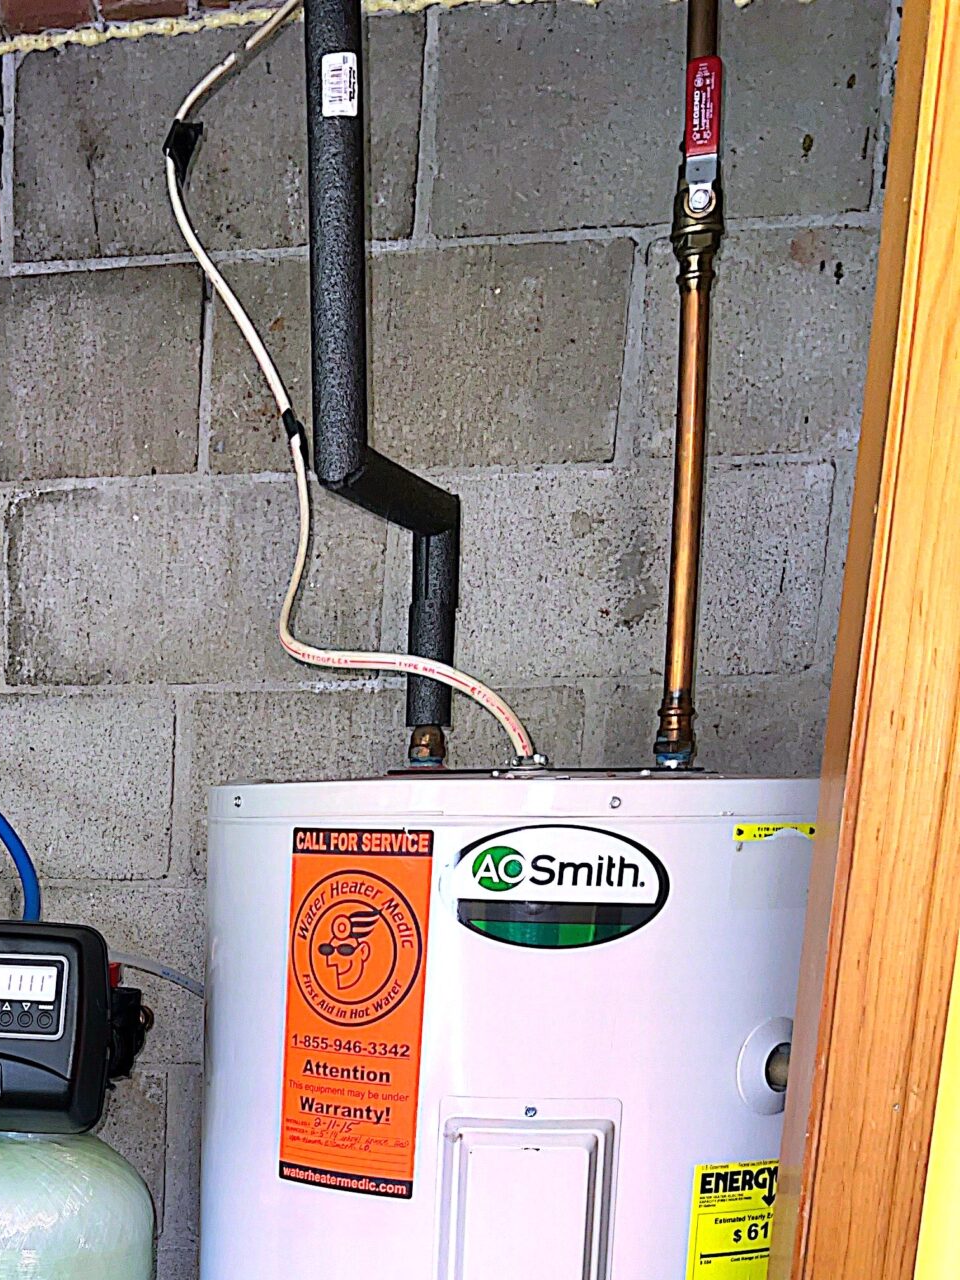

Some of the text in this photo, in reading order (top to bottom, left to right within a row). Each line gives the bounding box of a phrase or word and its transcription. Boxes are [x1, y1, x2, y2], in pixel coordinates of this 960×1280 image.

[296, 832, 429, 852] CALL FOR SERVICE
[298, 881, 414, 949] Water Heater Medic
[303, 973, 318, 1000] First
[317, 999, 335, 1014] Aid
[350, 1009, 370, 1019] Hot
[372, 979, 402, 1012] Water
[292, 1033, 410, 1057] 1-855-946-3342
[303, 1059, 391, 1083] Attention
[289, 1080, 409, 1101] This equipment may be under
[300, 1096, 391, 1124] Warranty!
[283, 1167, 406, 1194] waterheatermedic.com
[715, 1216, 745, 1224] Estimated
[733, 1221, 768, 1243] $ 61
